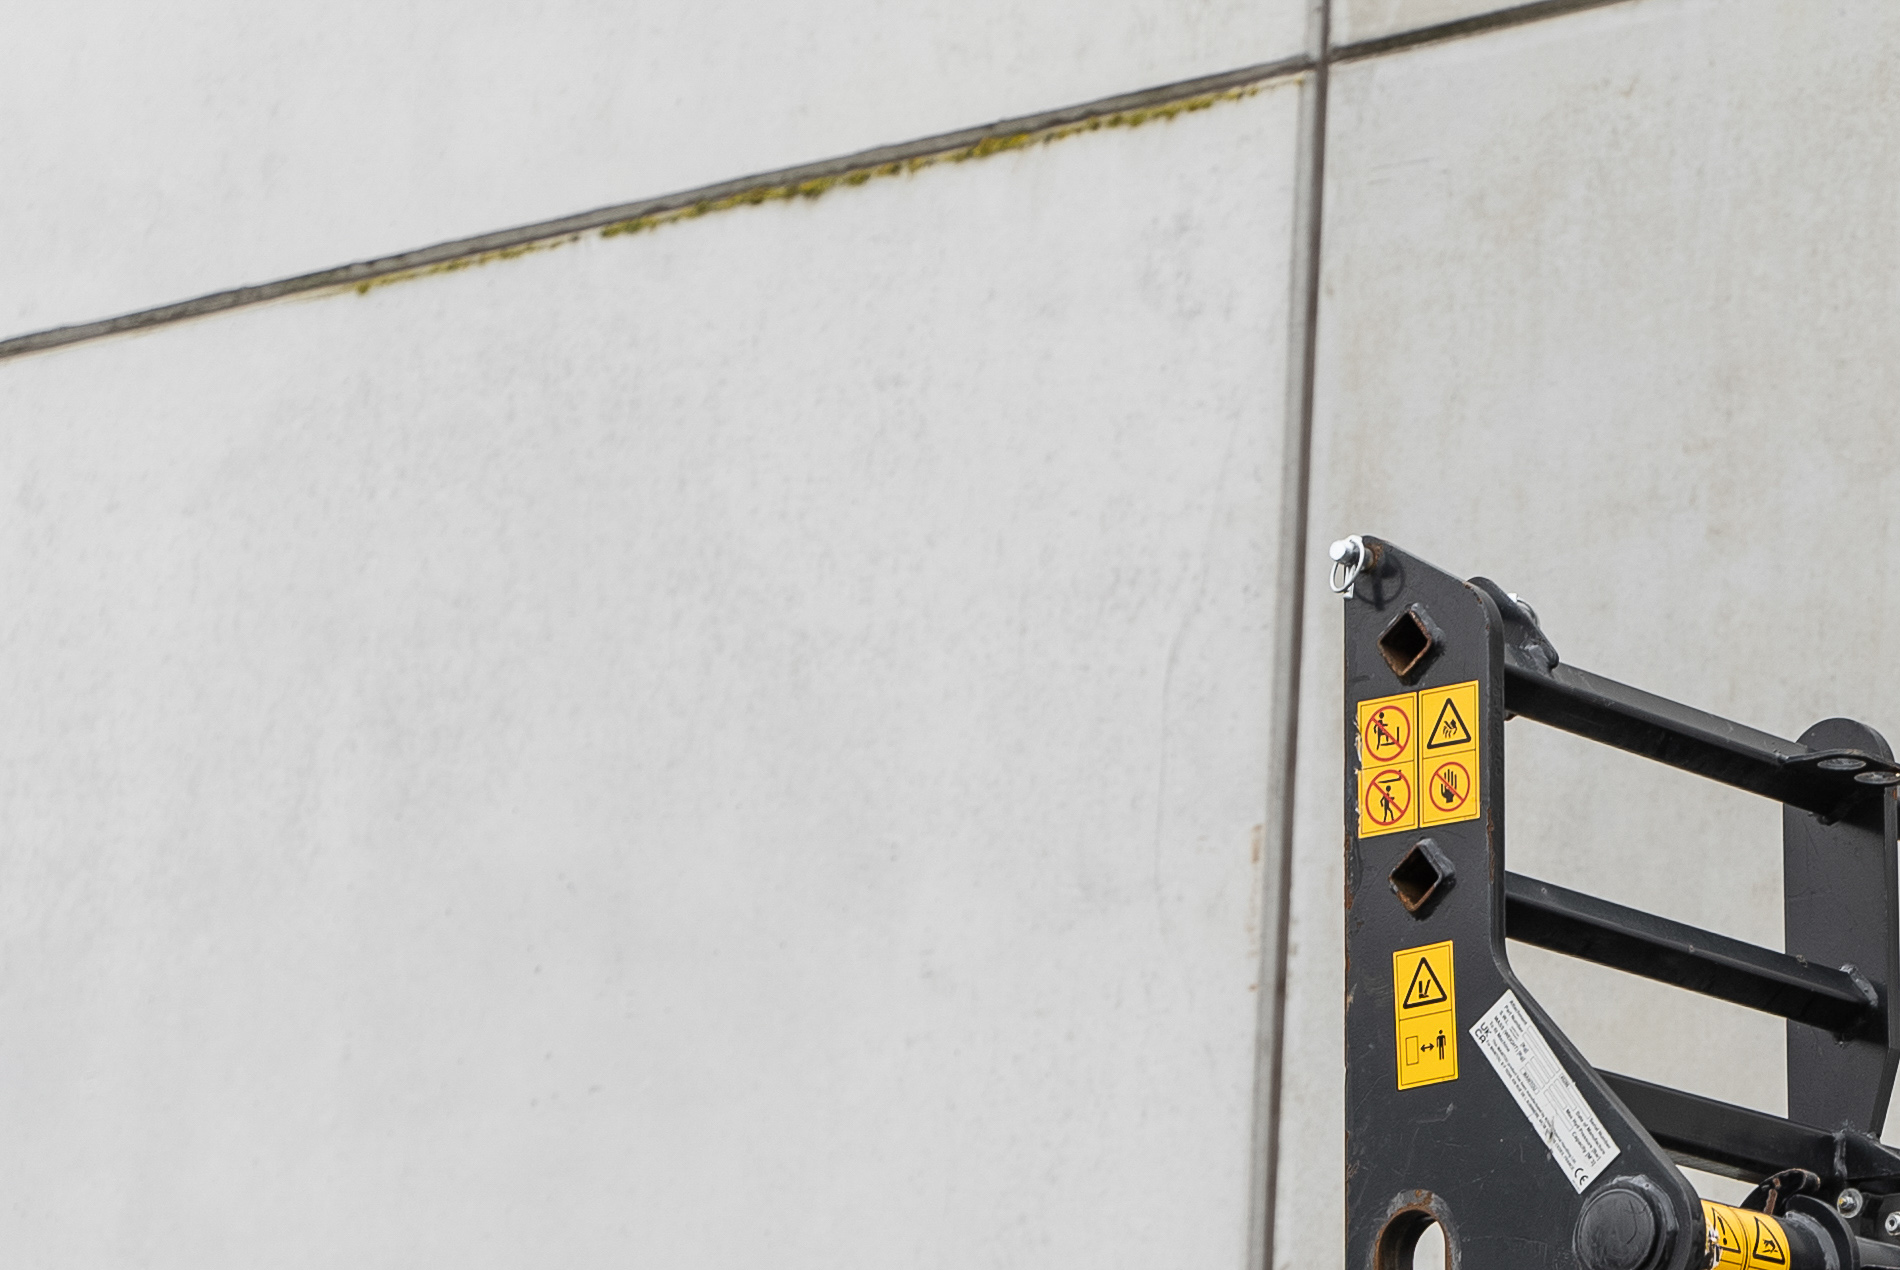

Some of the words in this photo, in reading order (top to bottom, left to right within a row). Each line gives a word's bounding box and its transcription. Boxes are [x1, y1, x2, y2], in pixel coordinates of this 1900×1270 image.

[1493, 1015, 1505, 1031] MASS
[1503, 1004, 1513, 1016] Part
[1510, 1014, 1524, 1033] Number
[1509, 999, 1528, 1026] Attachment
[1474, 1027, 1487, 1044] CA
[1479, 1021, 1492, 1038] UK
[1496, 1032, 1511, 1053] Machine
[1571, 1131, 1587, 1154] Capacity
[1575, 1110, 1585, 1123] Date
[1586, 1126, 1606, 1155] Manufacture
[1578, 1127, 1594, 1149] Pressure
[1589, 1117, 1600, 1132] Serial
[1597, 1130, 1612, 1149] Number
